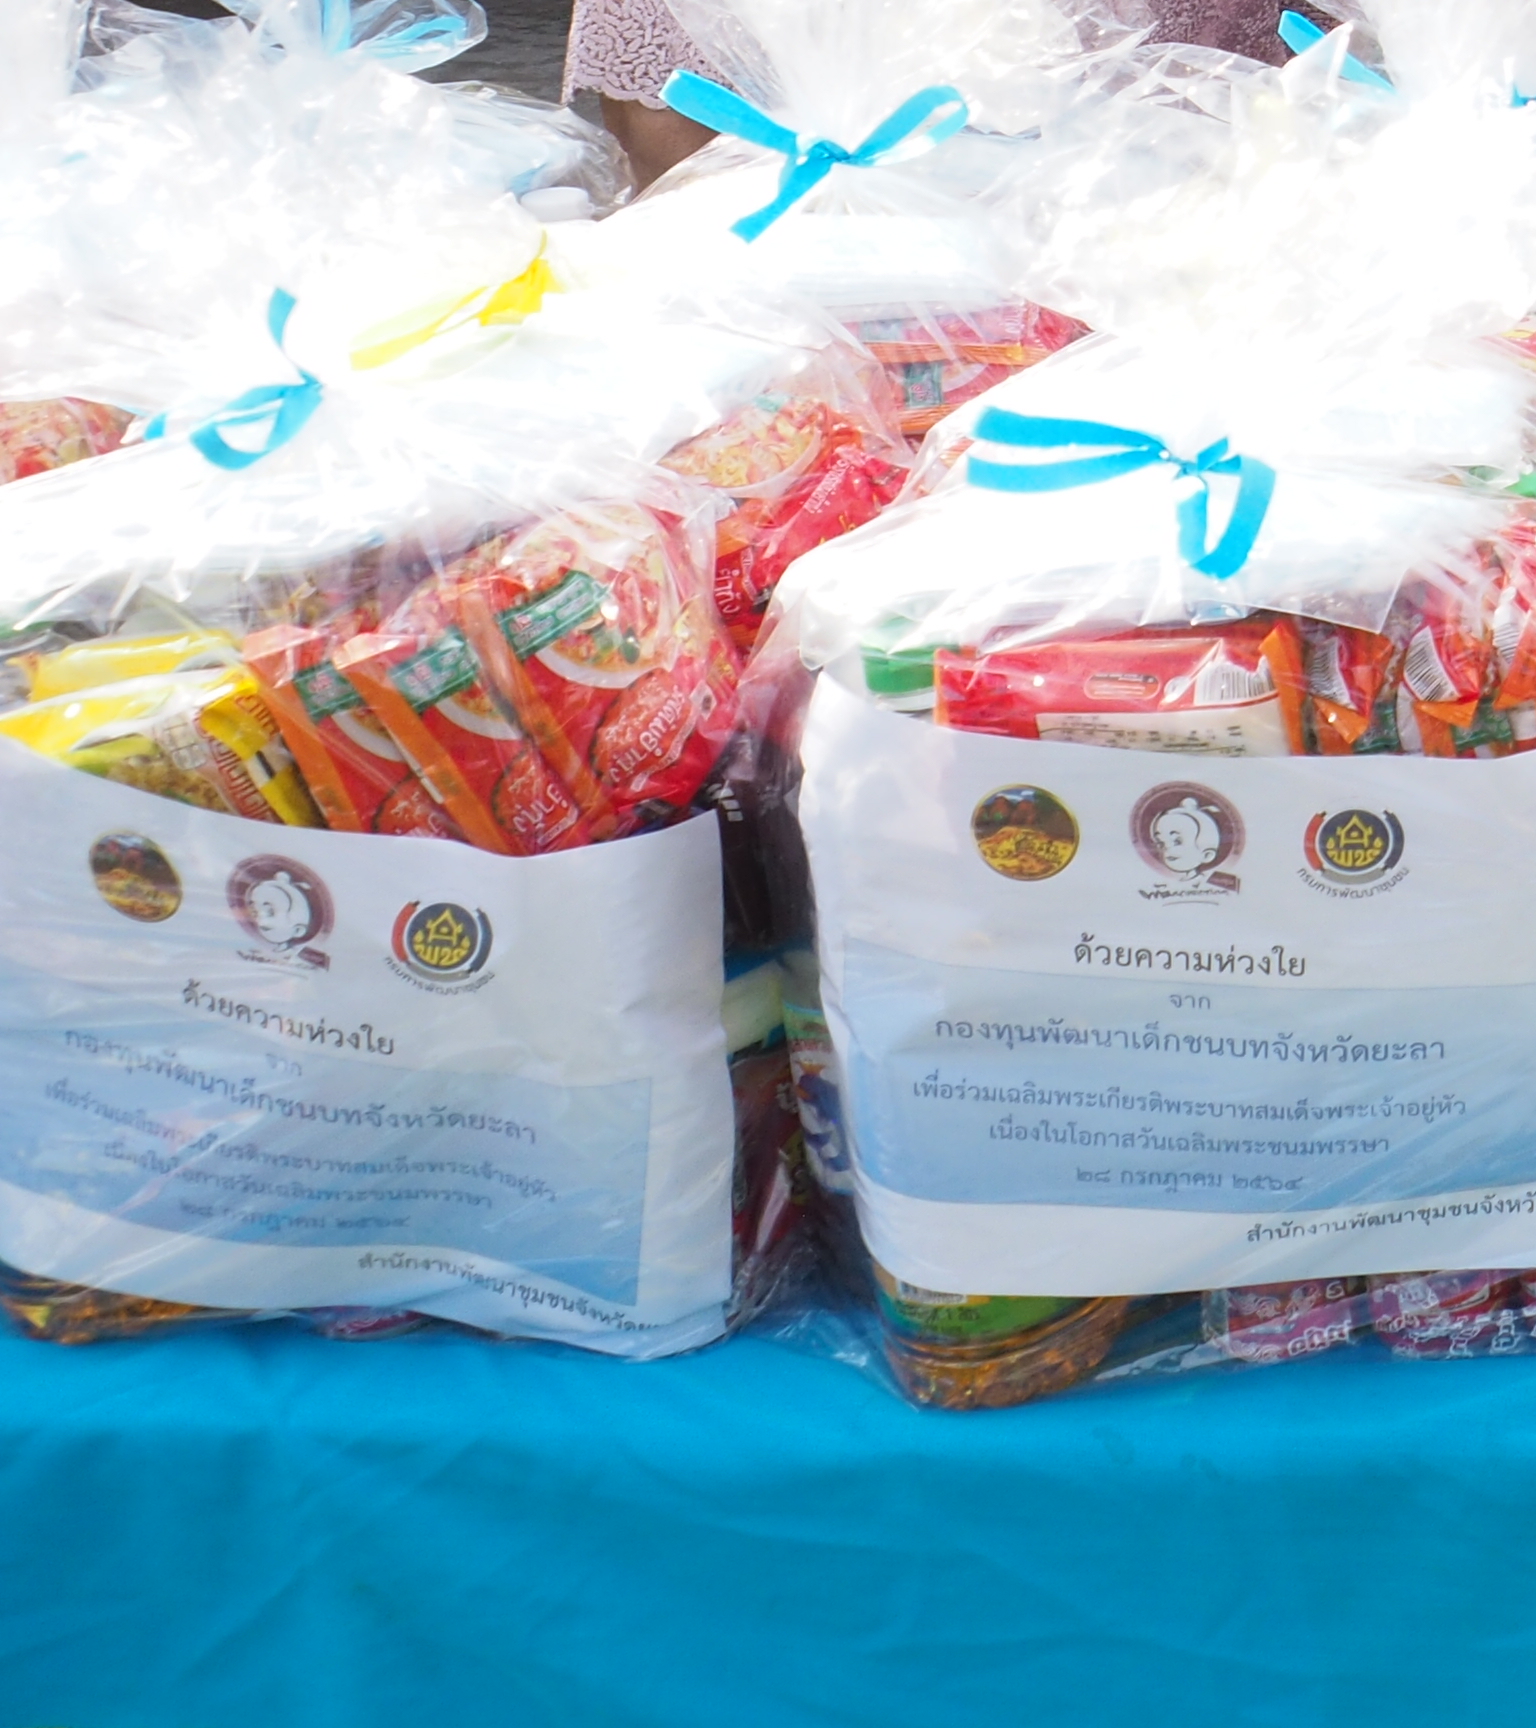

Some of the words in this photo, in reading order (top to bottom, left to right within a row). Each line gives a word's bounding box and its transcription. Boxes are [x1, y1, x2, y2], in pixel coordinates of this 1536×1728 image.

[1073, 931, 1307, 977] ด้วยความห่วงใย
[182, 977, 395, 1056] ด้วยความห่วงใย
[1169, 993, 1212, 1010] จาก
[934, 1017, 1446, 1064] กองทุนพัฒนาเด็กชนบทจังหวัดยะลา
[64, 1029, 537, 1145] กองทุนพัฒนาเด็กชนบทจังหวัดยะลา
[912, 1068, 1467, 1124] เพื่อร่วมเฉลิมพระเกียรติพระบาทสมเด็จพระเจ้าอยู่หัว
[988, 1113, 1391, 1157] เนื่องในโอกาสวันเฉลิมพระชนมพรรษา
[1120, 1168, 1223, 1193] กรกฎาคม
